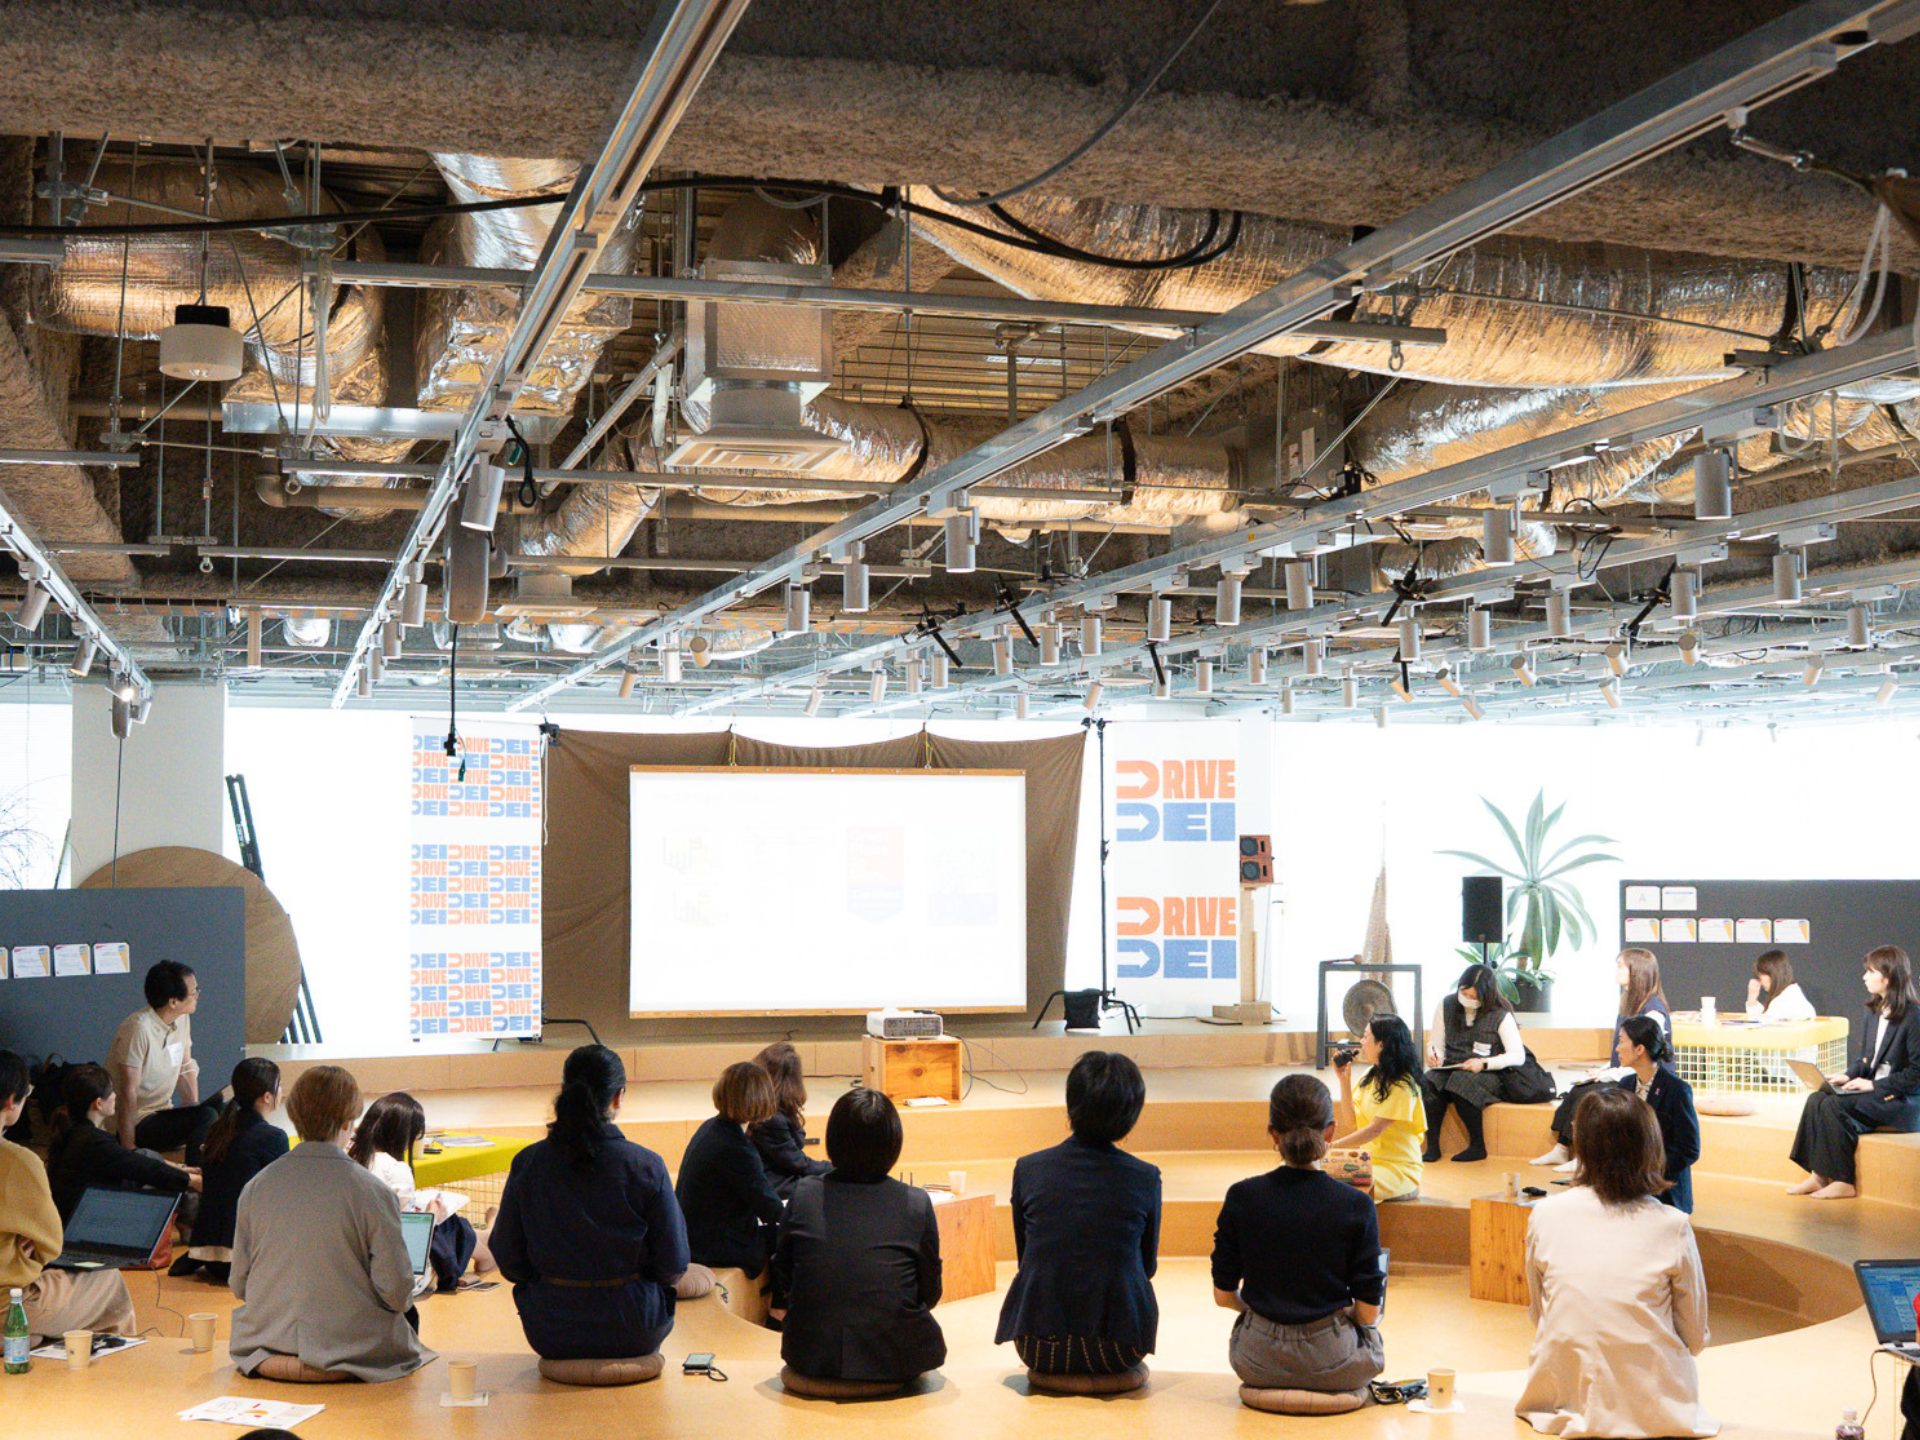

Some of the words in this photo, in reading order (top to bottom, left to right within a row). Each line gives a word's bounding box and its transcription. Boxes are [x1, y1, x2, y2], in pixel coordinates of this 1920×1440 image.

[491, 738, 530, 754] DEI
[412, 752, 448, 767] DRIVE
[490, 754, 530, 770] DRIVE
[490, 770, 530, 785] DEI
[1116, 760, 1236, 799] DRIVE
[412, 784, 448, 799] DRIVE
[449, 785, 489, 800] DEI
[490, 786, 530, 801] DRIVE
[449, 801, 488, 816] DRIVE
[490, 802, 530, 817] DEI
[1116, 802, 1236, 841] DEI
[448, 844, 488, 860] DRIVE
[489, 845, 530, 860] DEI
[411, 860, 447, 875] DRIVE
[448, 861, 488, 876] DEI
[489, 861, 530, 876] DRIVE
[448, 877, 488, 892] DRIVE
[489, 877, 530, 892] DEI
[411, 893, 447, 908] DRIVE
[448, 893, 488, 908] DEI
[489, 893, 530, 908] DRIVE
[448, 909, 488, 924] DRIVE
[490, 909, 530, 924] DEI
[1117, 897, 1236, 936] DRIVE
[448, 952, 489, 968] DRIVE
[490, 952, 530, 967] DEI
[1117, 939, 1237, 978] DEI
[410, 969, 447, 984] DRIVE
[448, 969, 489, 984] DEI
[491, 968, 531, 983] DRIVE
[448, 985, 491, 1000] DRIVE
[492, 984, 531, 999] DEI
[410, 1002, 447, 1017] DRIVE
[448, 1001, 491, 1016] DEI
[492, 1000, 532, 1015] DRIVE
[449, 1017, 492, 1033] DRIVE
[493, 1016, 531, 1031] DEI
